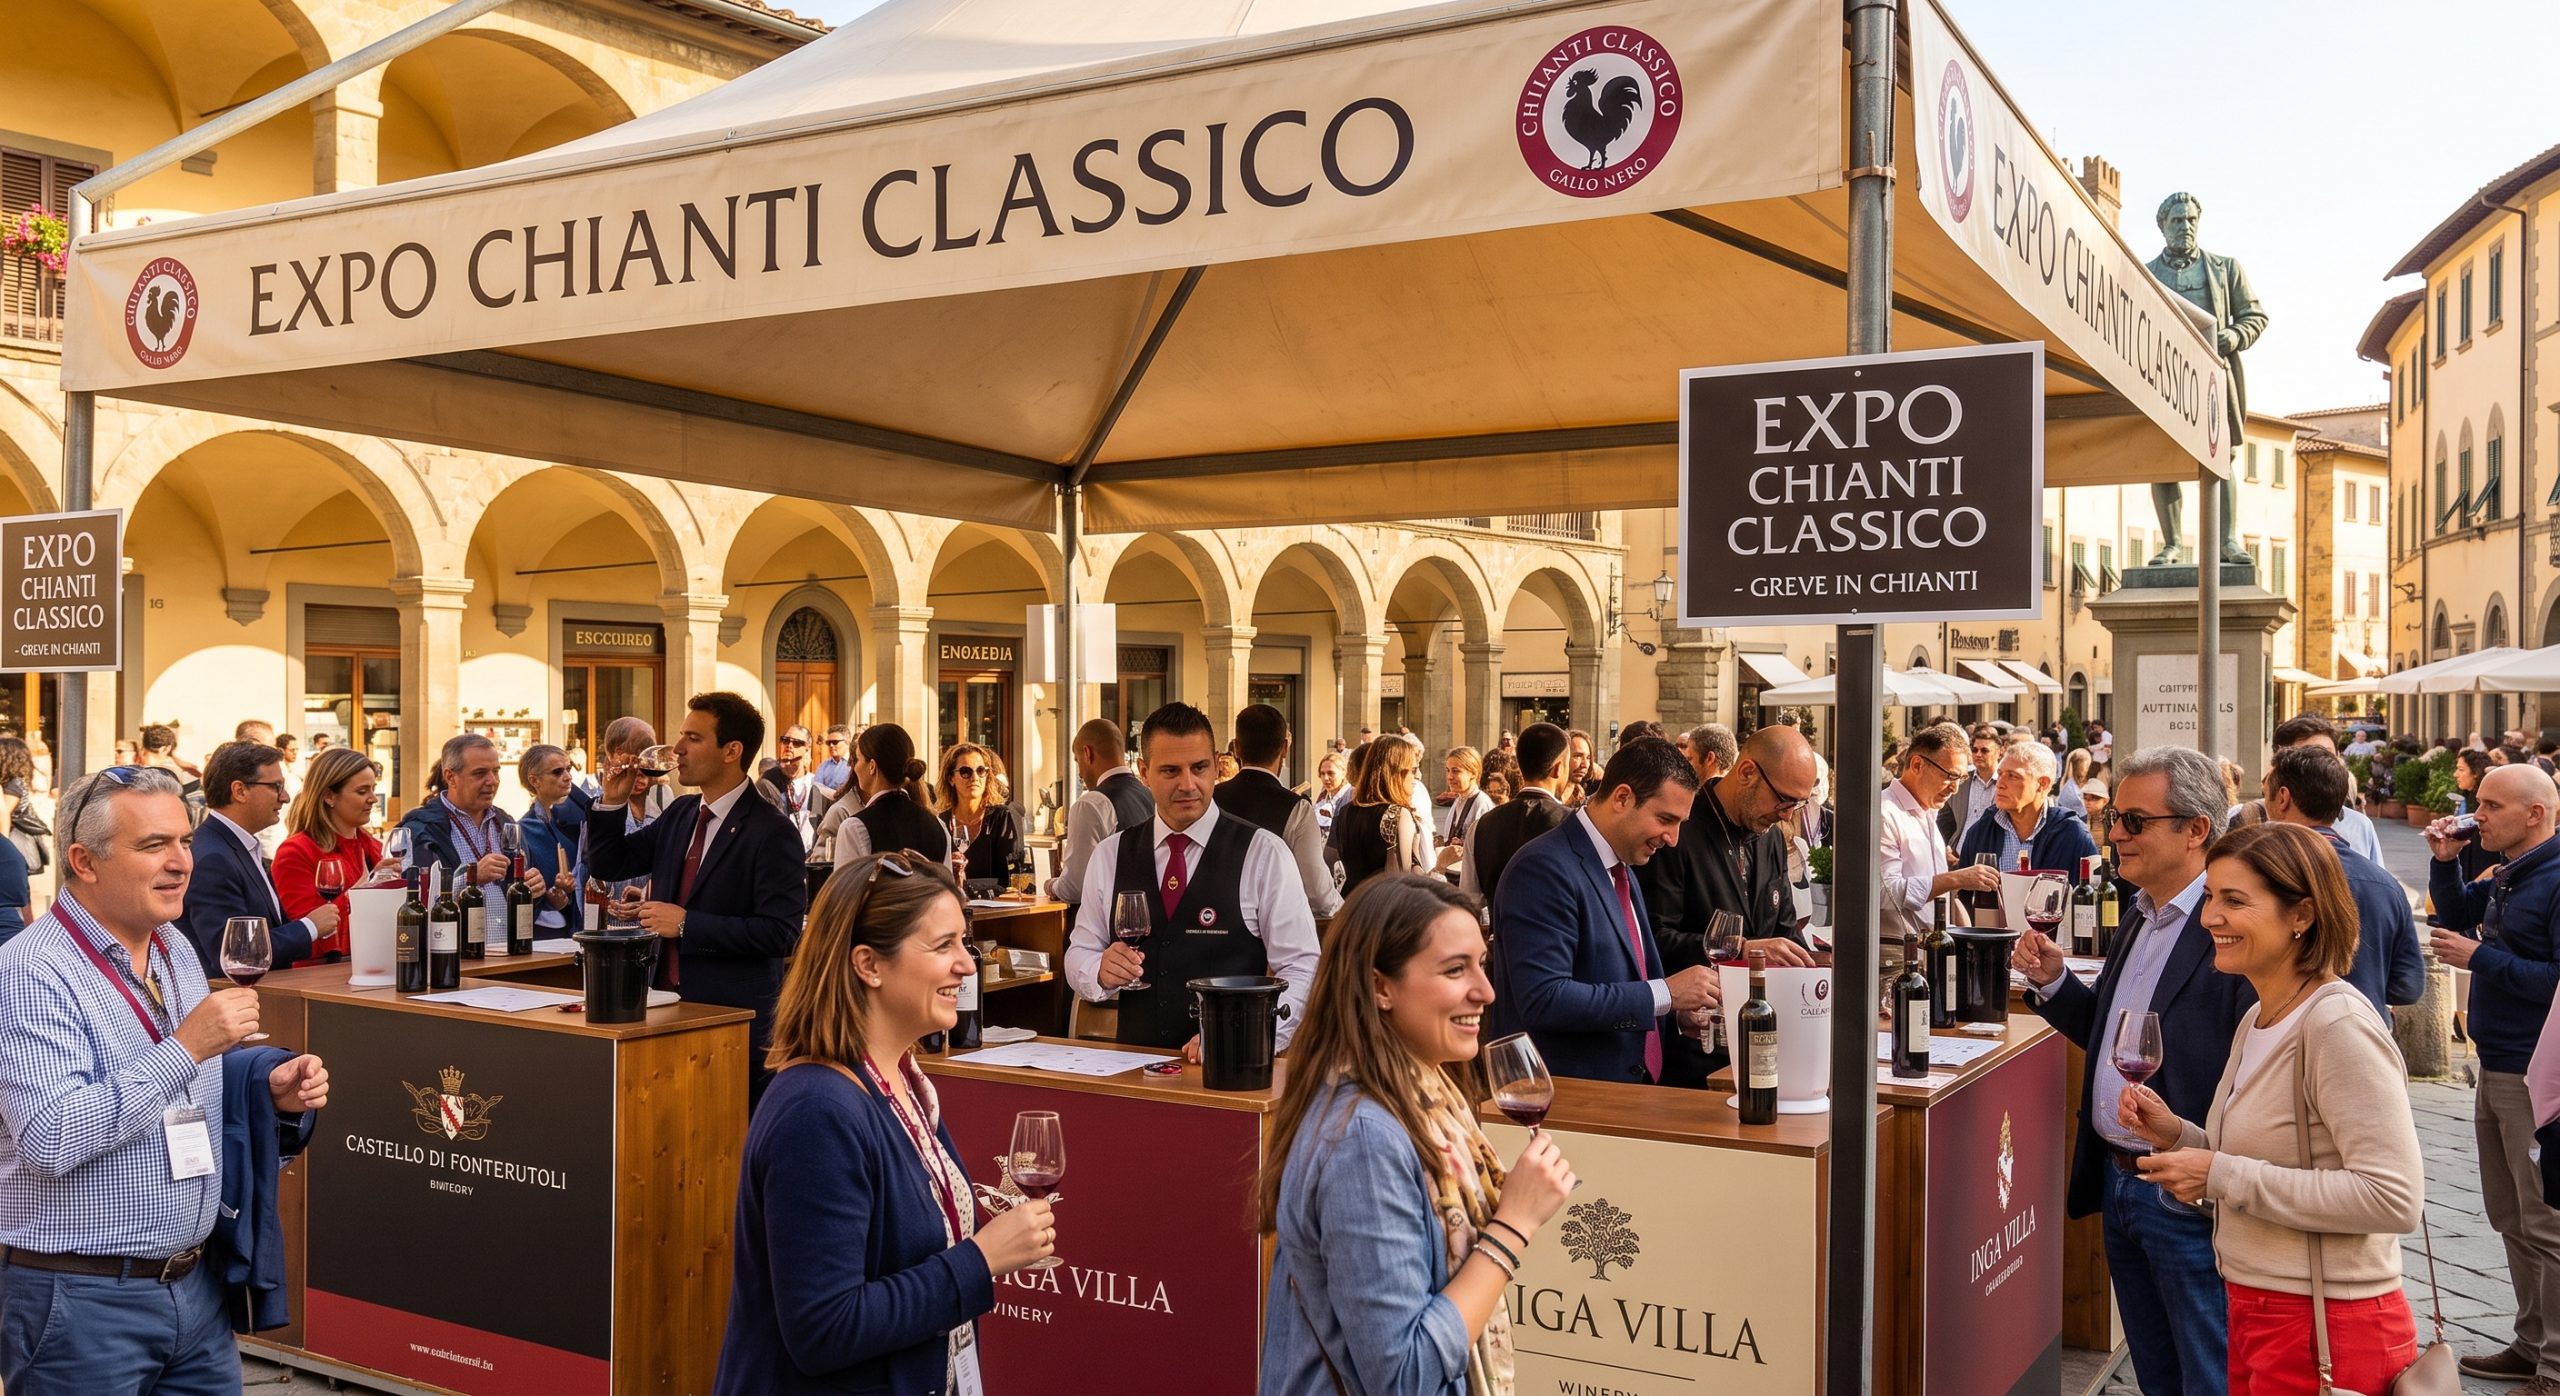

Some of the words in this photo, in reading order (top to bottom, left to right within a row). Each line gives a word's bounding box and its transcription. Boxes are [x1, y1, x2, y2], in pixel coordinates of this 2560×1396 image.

[1602, 32, 1677, 117] CLASSICO
[1550, 169, 1599, 191] GALLO
[1603, 157, 1647, 189] NERO
[248, 241, 437, 336] EXPO
[467, 182, 823, 309] CHIANTI
[862, 96, 1415, 258] CLASSICO
[1993, 143, 2056, 286] EXPO
[2063, 227, 2133, 367] CHIANTI
[2137, 310, 2199, 427] CLASSICO
[1753, 384, 1963, 455] EXPO
[1748, 456, 1964, 505] CHIANTI
[23, 531, 96, 570] EXPO
[1727, 506, 1987, 555] CLASSICO
[21, 574, 96, 600] CHIANTI
[1750, 575, 1828, 598] GREVE
[1836, 573, 1862, 595] IN
[1870, 570, 1979, 594] CHIANTI
[13, 604, 104, 630] CLASSICO
[21, 644, 49, 656] GREVE
[51, 643, 61, 655] IN
[62, 642, 101, 655] CHIANTI
[346, 1134, 424, 1164] CASTELLO
[429, 1149, 445, 1168] DI
[450, 1153, 567, 1190] FONTERUTOLI
[1971, 1232, 2002, 1284] INGA
[2004, 1204, 2036, 1253] VILLA
[1069, 1265, 1174, 1314] VILLA
[1613, 1298, 1768, 1365] VILLA
